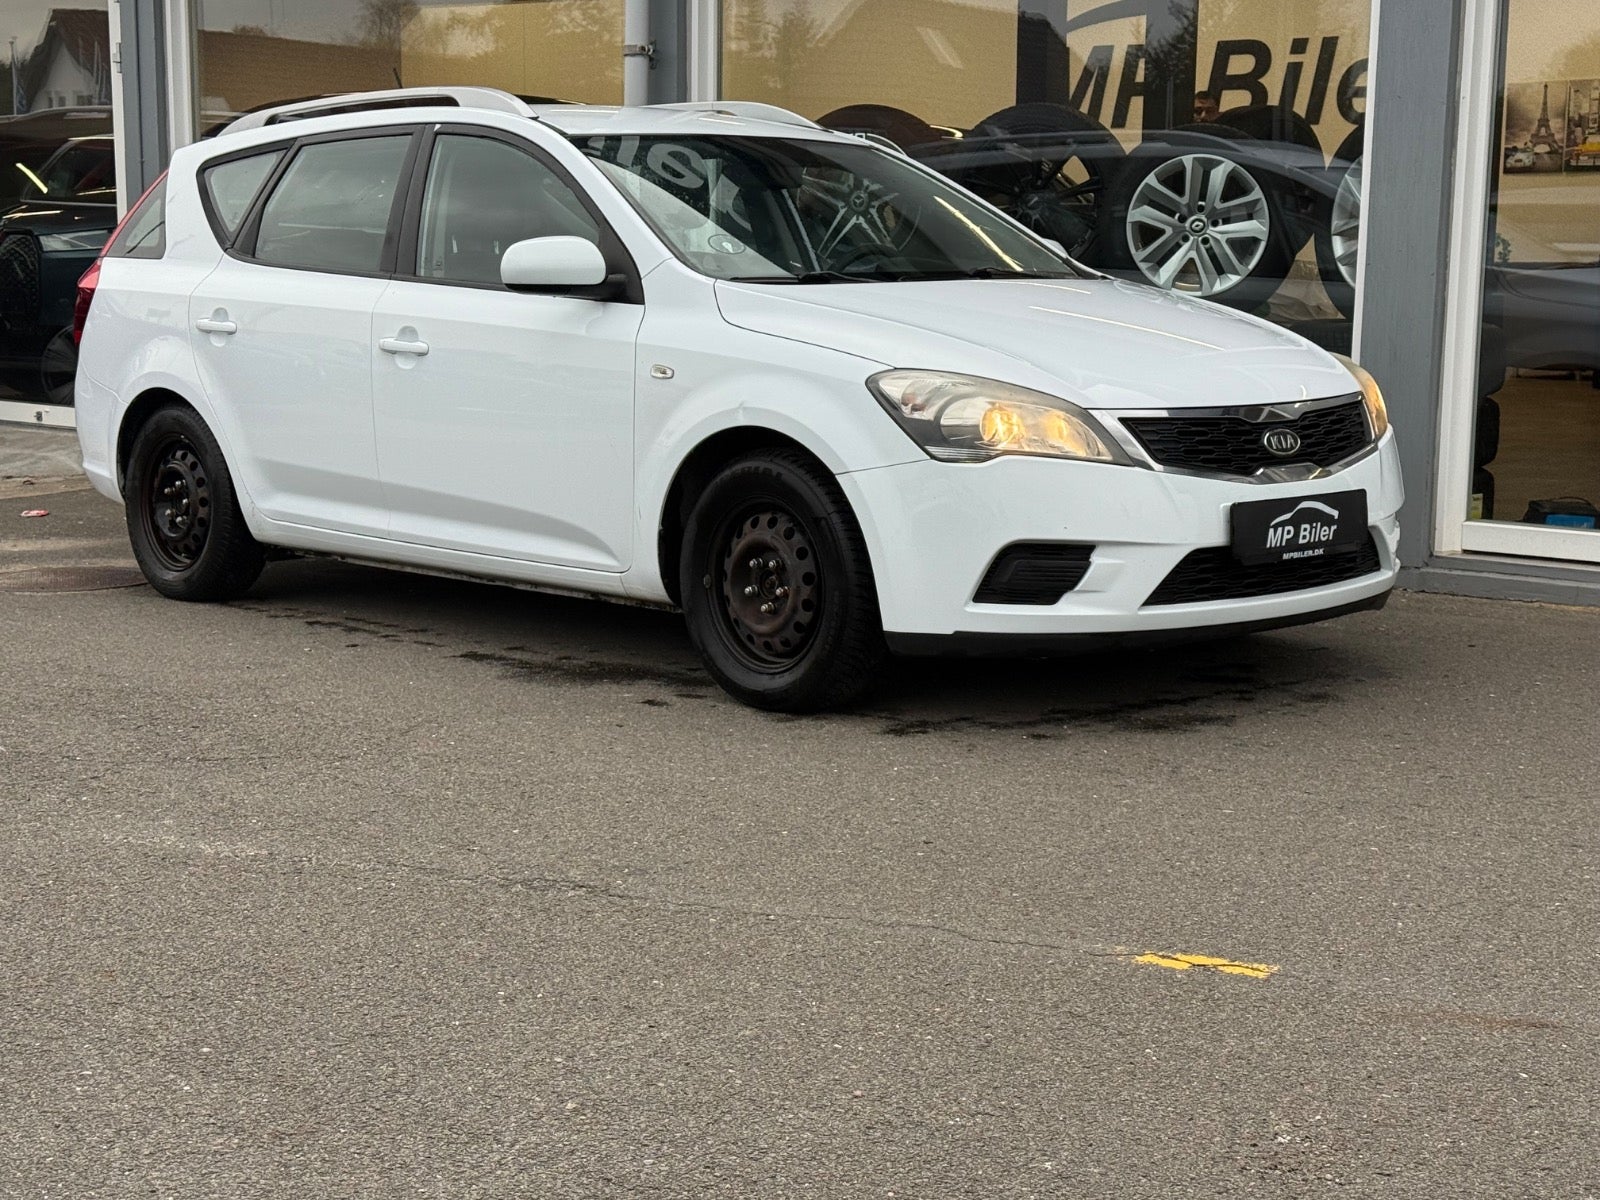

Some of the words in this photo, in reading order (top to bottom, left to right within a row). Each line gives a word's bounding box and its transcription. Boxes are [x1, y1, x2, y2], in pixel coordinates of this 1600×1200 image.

[1269, 432, 1296, 450] KIA
[1266, 525, 1295, 549] MP
[1298, 522, 1338, 545] Biler
[1282, 548, 1325, 560] MPBILER.DK
